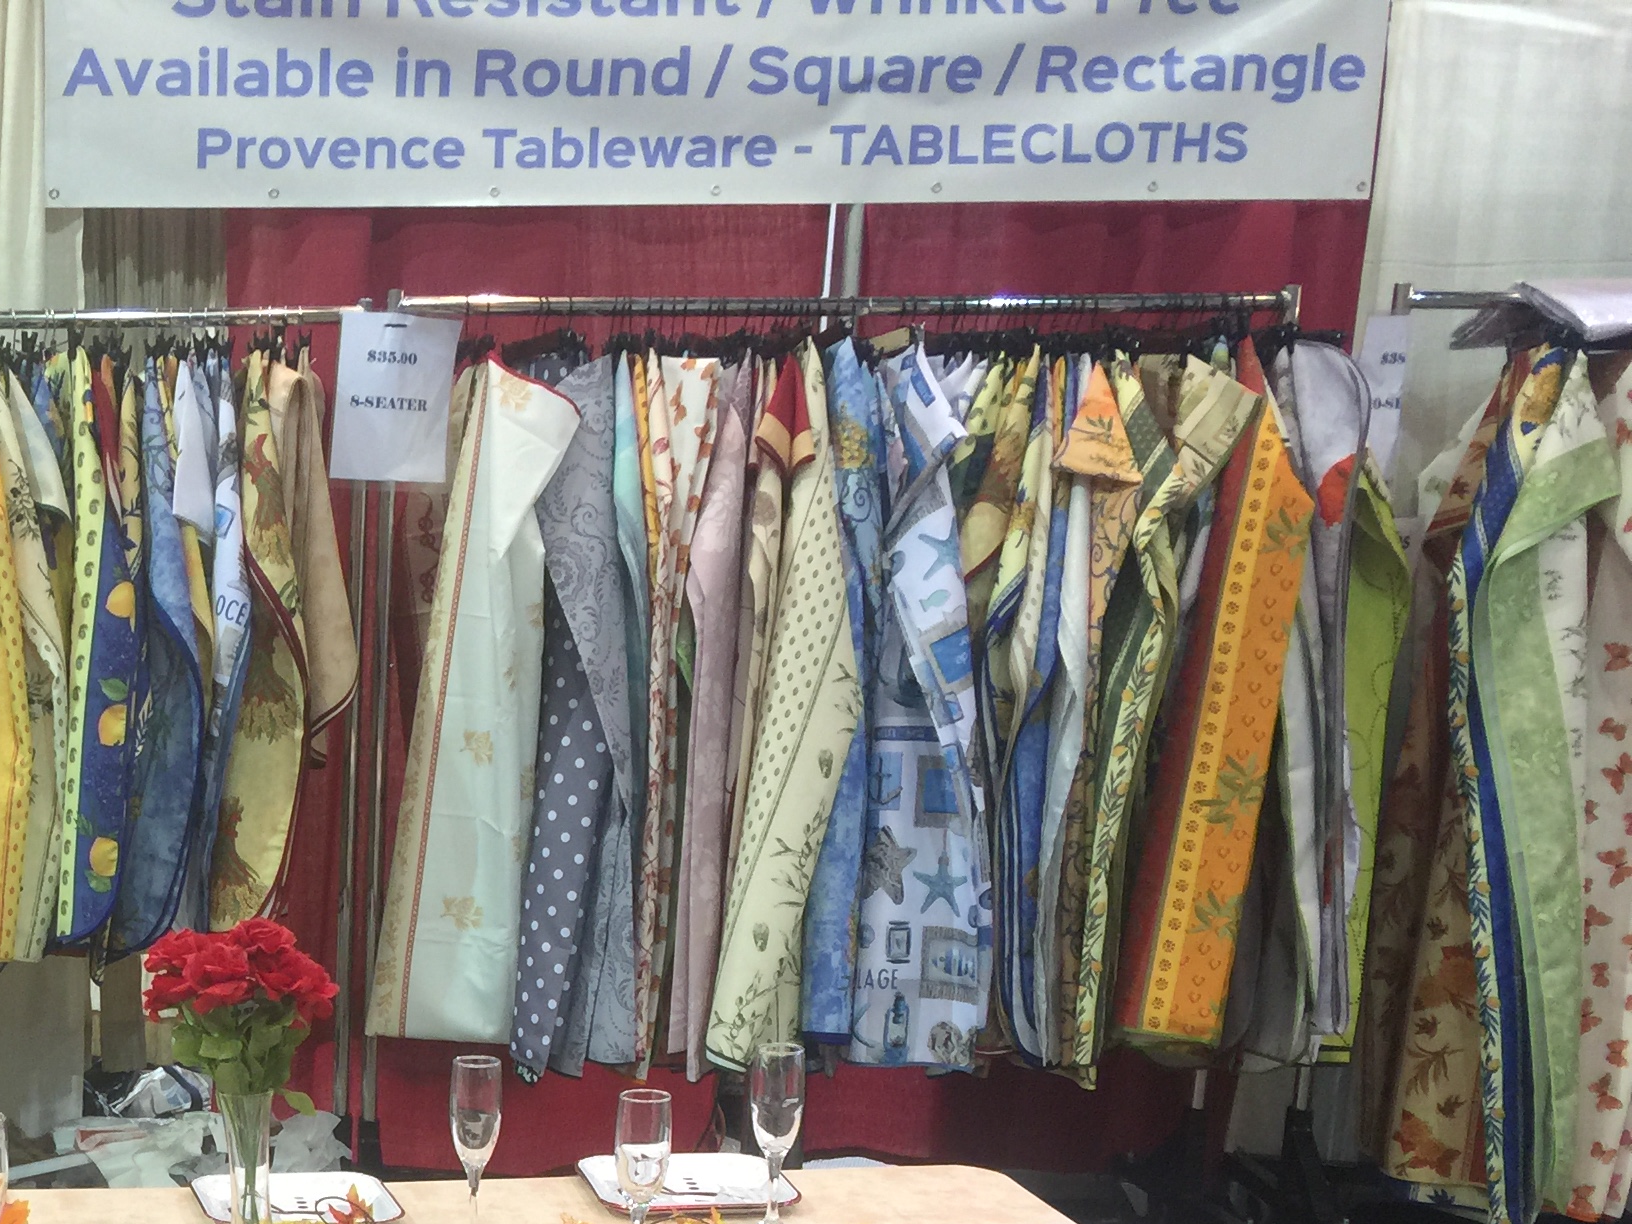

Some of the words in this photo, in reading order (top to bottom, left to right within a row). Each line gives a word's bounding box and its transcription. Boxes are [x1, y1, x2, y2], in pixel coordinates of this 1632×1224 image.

[63, 46, 375, 98] Available
[397, 46, 453, 98] in
[475, 46, 692, 98] Round
[705, 45, 734, 99] /
[747, 45, 984, 106] Square
[993, 45, 1026, 96] /
[1037, 43, 1367, 105] Rectangle
[196, 127, 467, 171] Provence
[483, 126, 778, 170] Tableware
[830, 121, 1250, 166] TABLECLOTHS
[366, 350, 418, 366] $35.00
[349, 394, 428, 412] 8-SEATER
